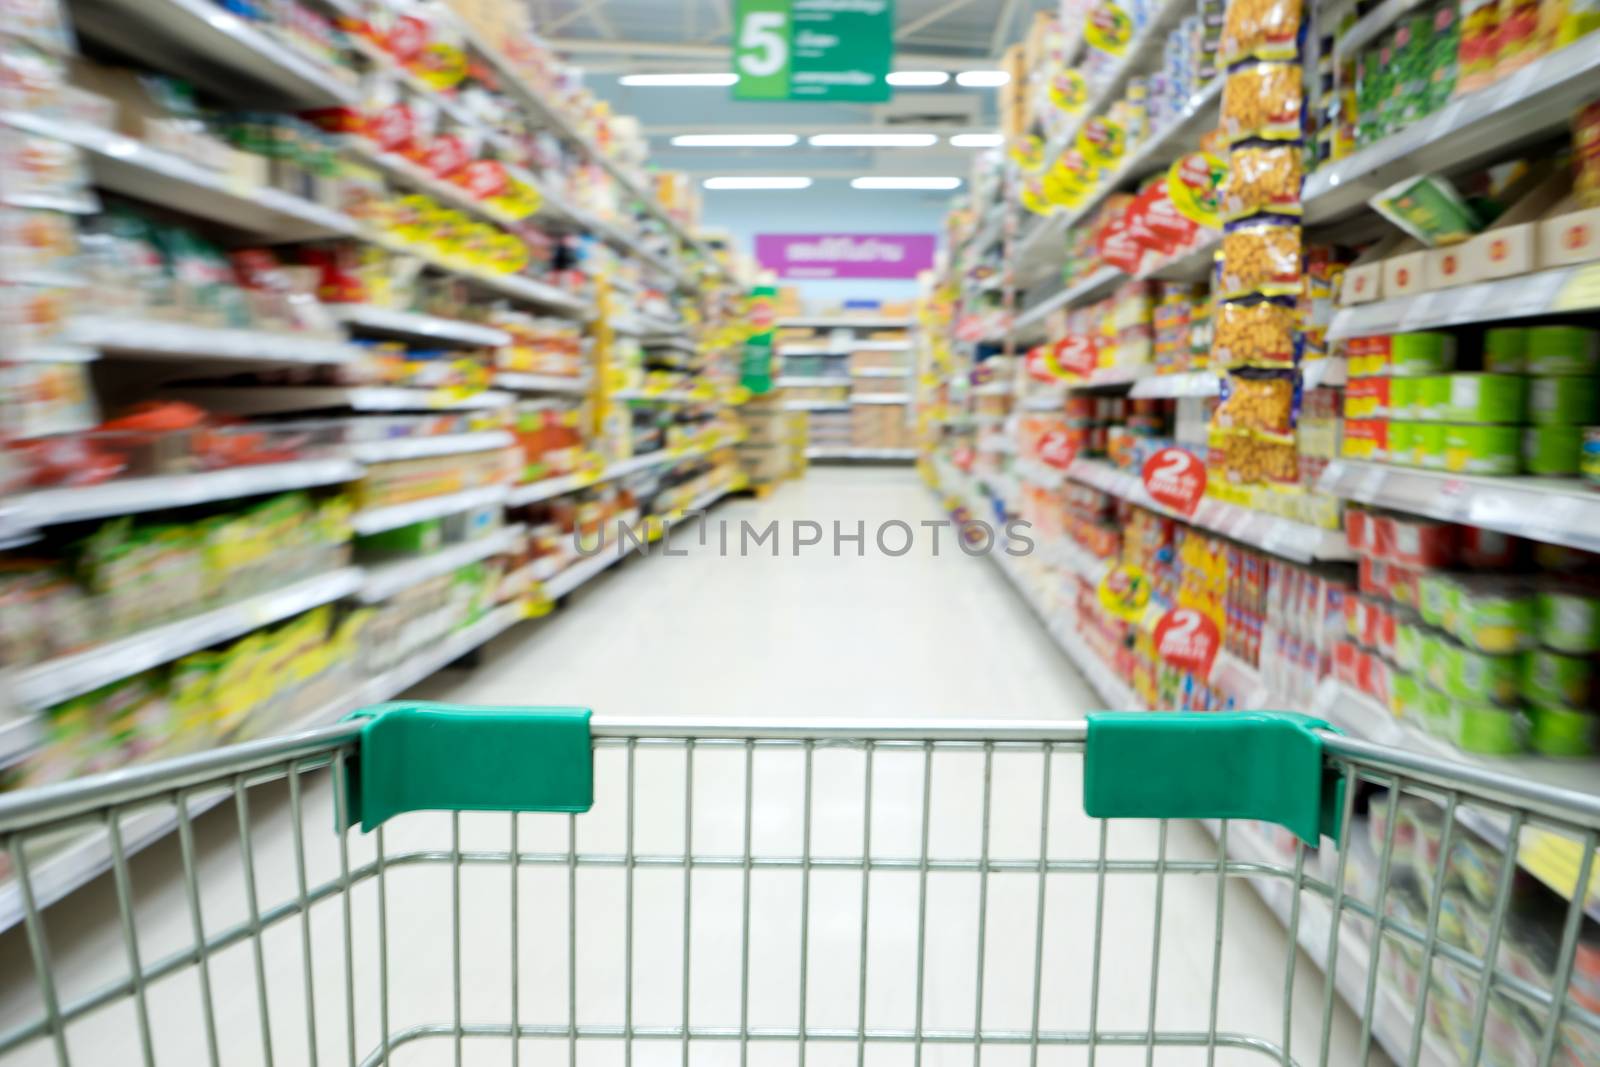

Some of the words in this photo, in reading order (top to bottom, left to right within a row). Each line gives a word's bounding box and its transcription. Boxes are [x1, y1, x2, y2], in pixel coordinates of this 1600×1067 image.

[738, 12, 787, 77] 5
[1152, 449, 1191, 482] 2
[1162, 609, 1200, 643] 2
